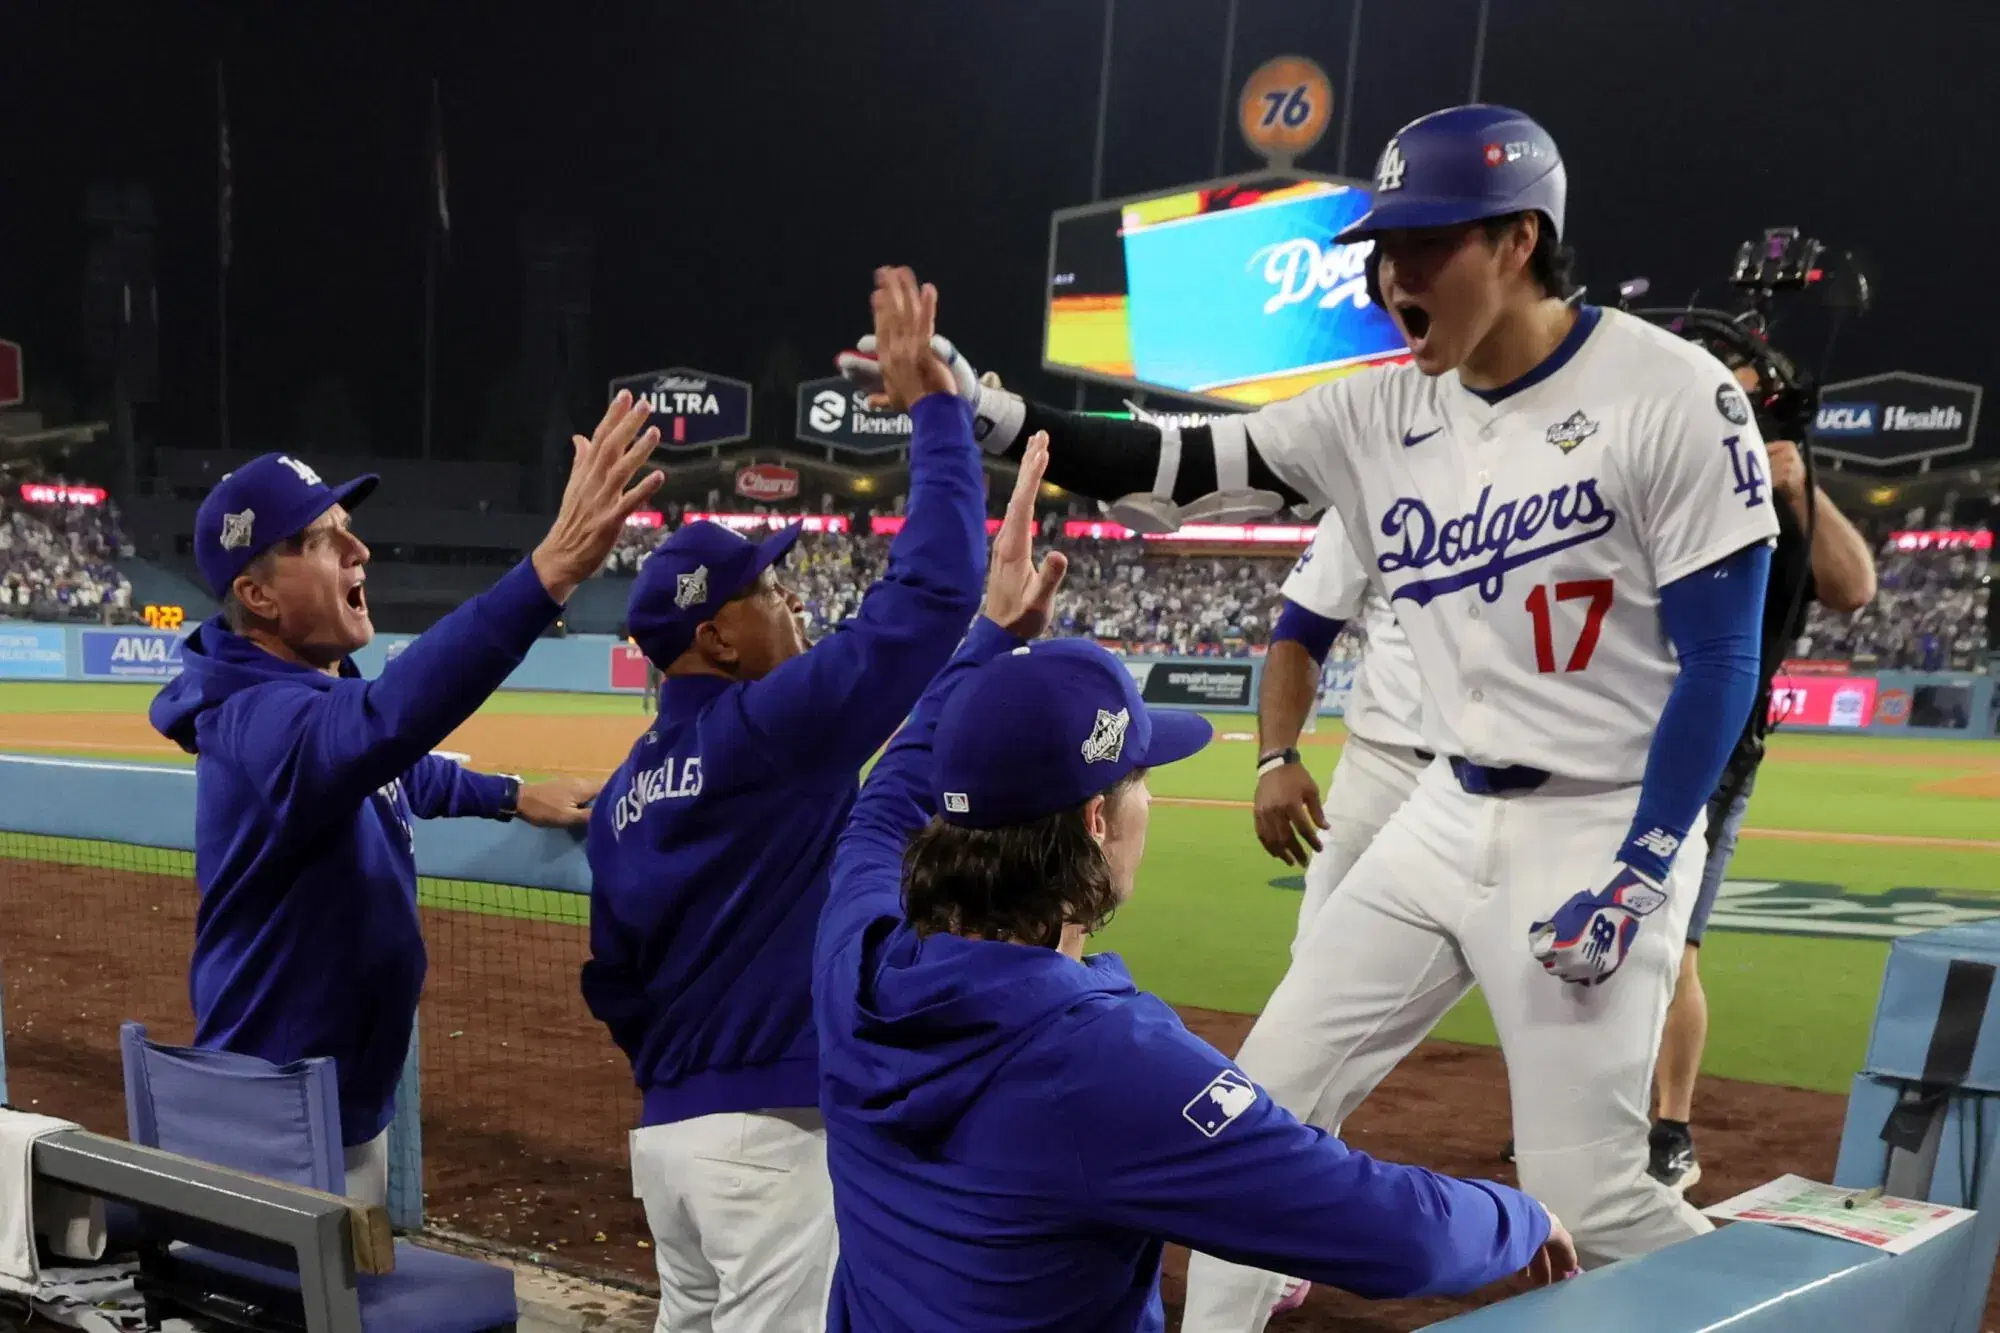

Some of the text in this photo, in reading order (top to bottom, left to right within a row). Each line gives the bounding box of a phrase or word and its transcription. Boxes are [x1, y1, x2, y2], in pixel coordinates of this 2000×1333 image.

[1261, 86, 1312, 127] 76
[1378, 138, 1406, 192] LA
[641, 391, 720, 416] ULTRA
[1816, 406, 1962, 431] UCLA Health
[1722, 435, 1765, 508] LA
[1378, 477, 1617, 607] Dodgers
[111, 637, 166, 662] ANA
[1525, 579, 1614, 673] 17
